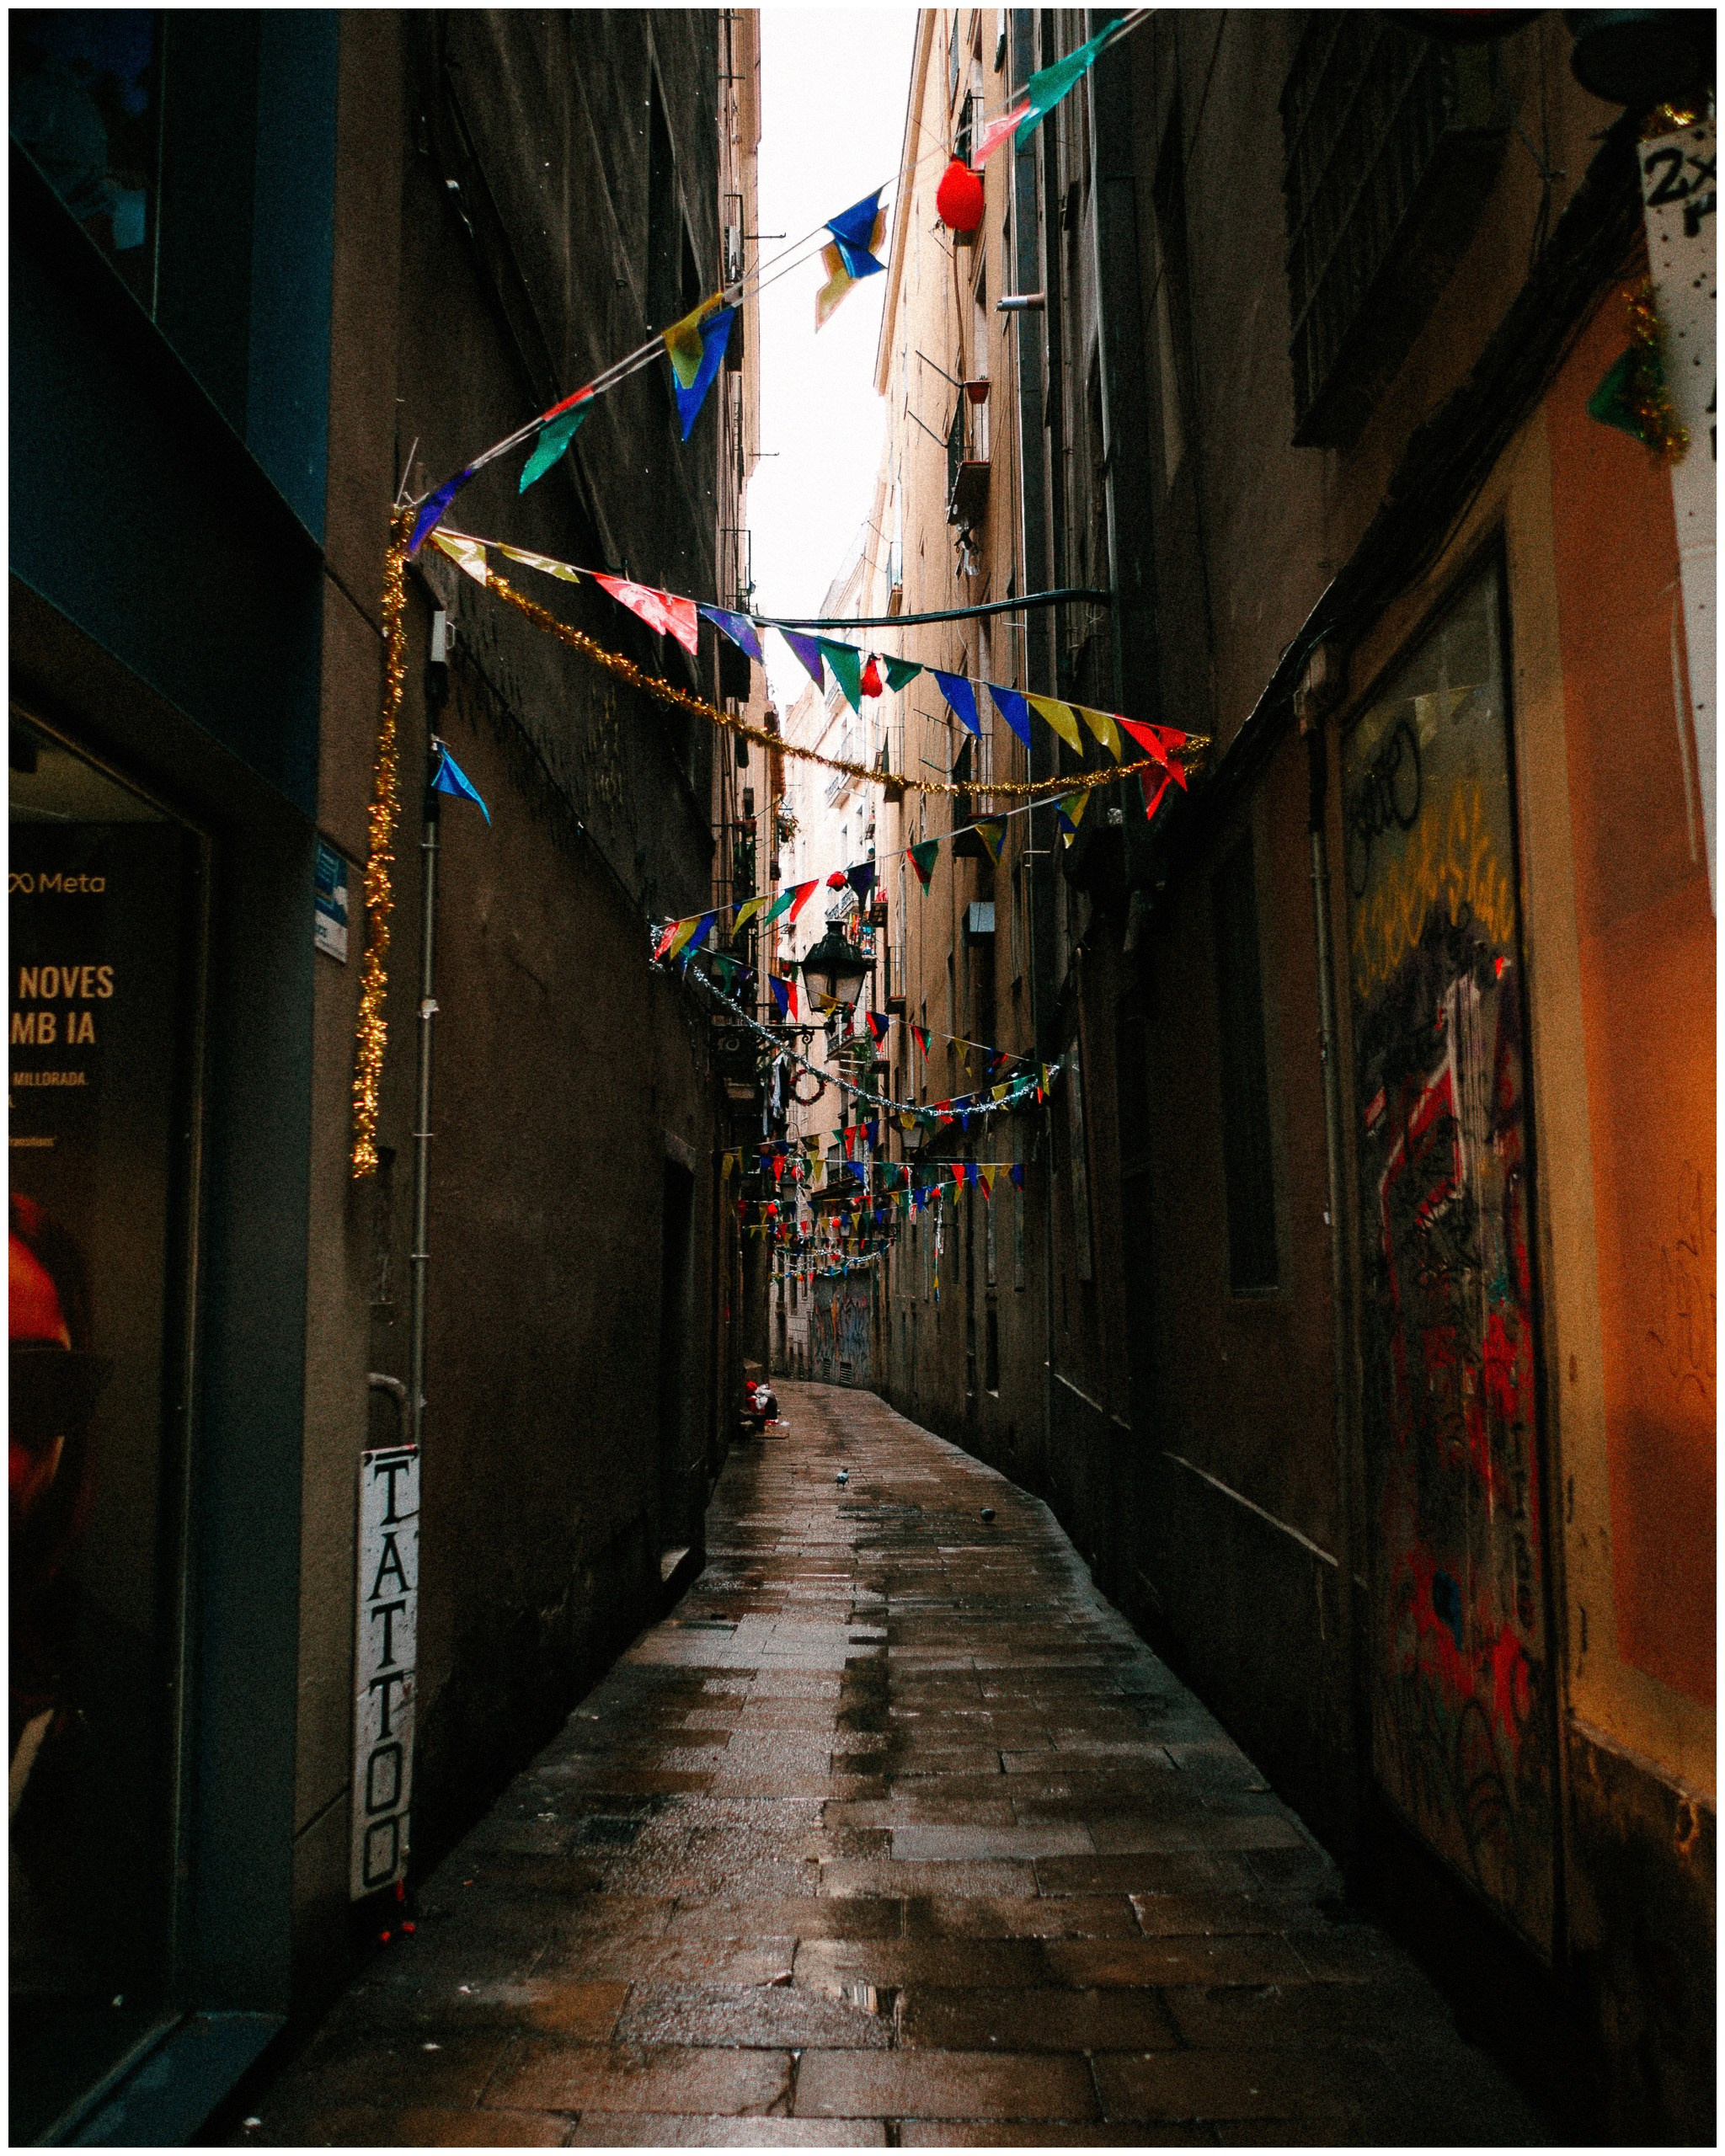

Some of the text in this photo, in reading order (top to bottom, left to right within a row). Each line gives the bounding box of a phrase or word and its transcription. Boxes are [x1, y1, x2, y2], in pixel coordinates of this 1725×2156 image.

[39, 873, 106, 894] Meta
[19, 964, 115, 999] NOVES
[67, 1011, 96, 1045] IA
[363, 1459, 411, 1888] TATTOO
